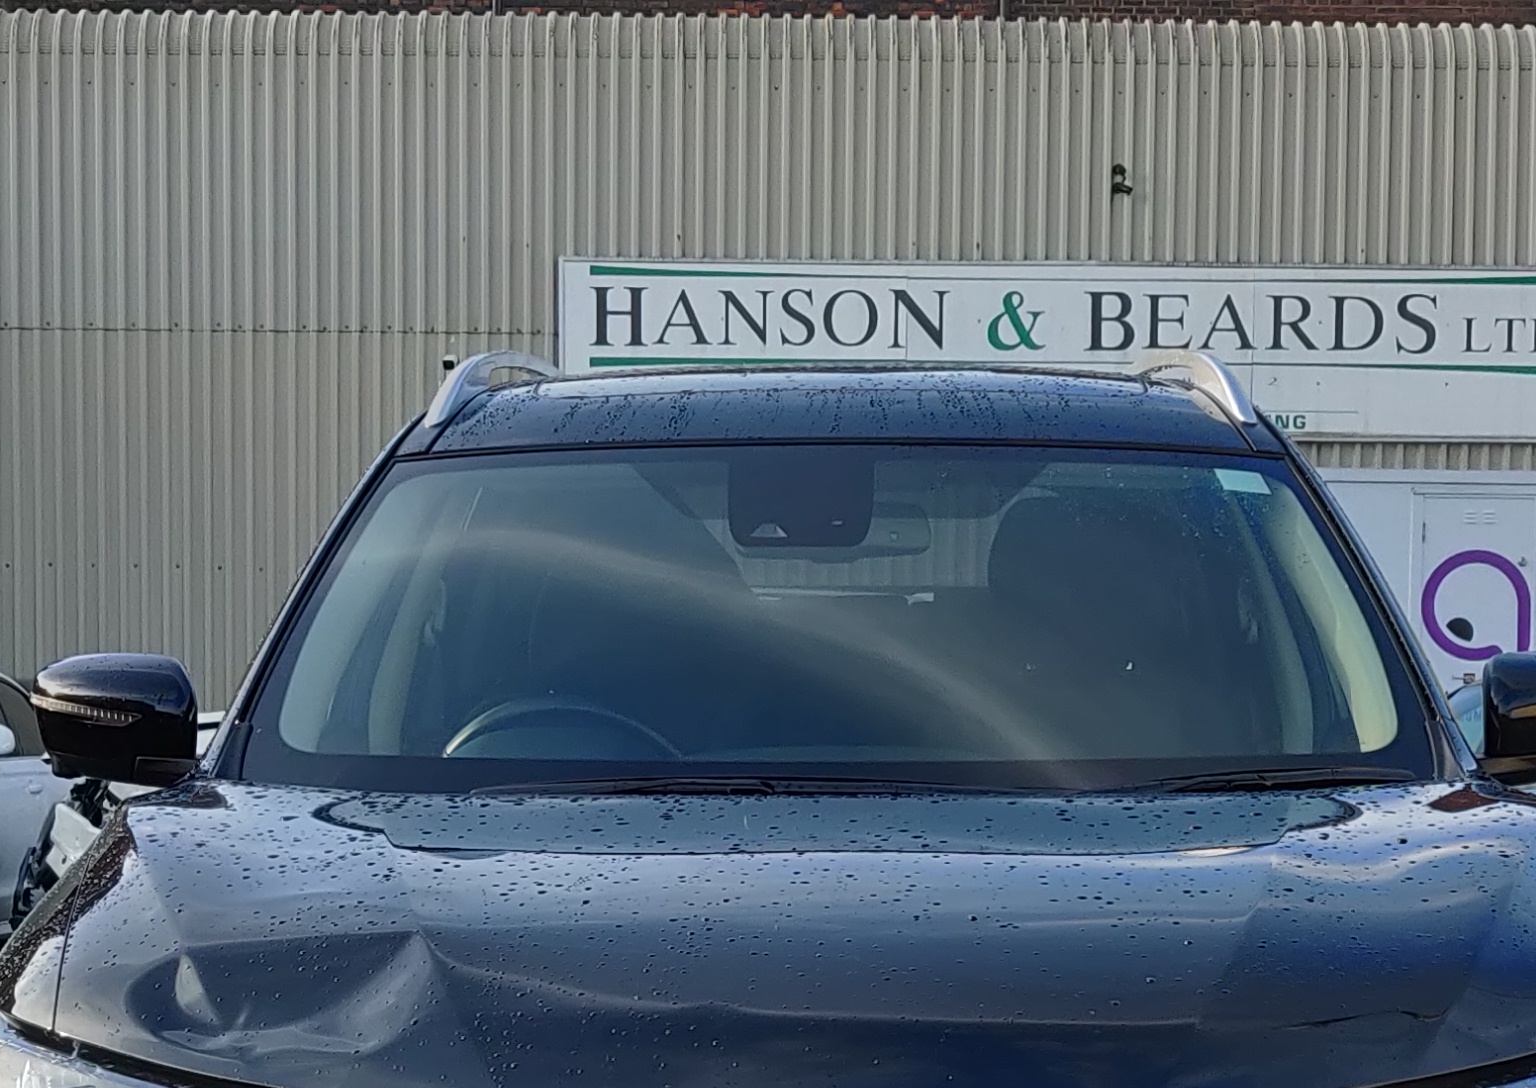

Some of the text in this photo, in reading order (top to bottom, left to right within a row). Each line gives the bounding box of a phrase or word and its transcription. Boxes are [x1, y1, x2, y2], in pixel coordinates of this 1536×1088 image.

[589, 286, 951, 350] HANSON
[987, 290, 1046, 351] &
[1083, 290, 1438, 354] BEARDS
